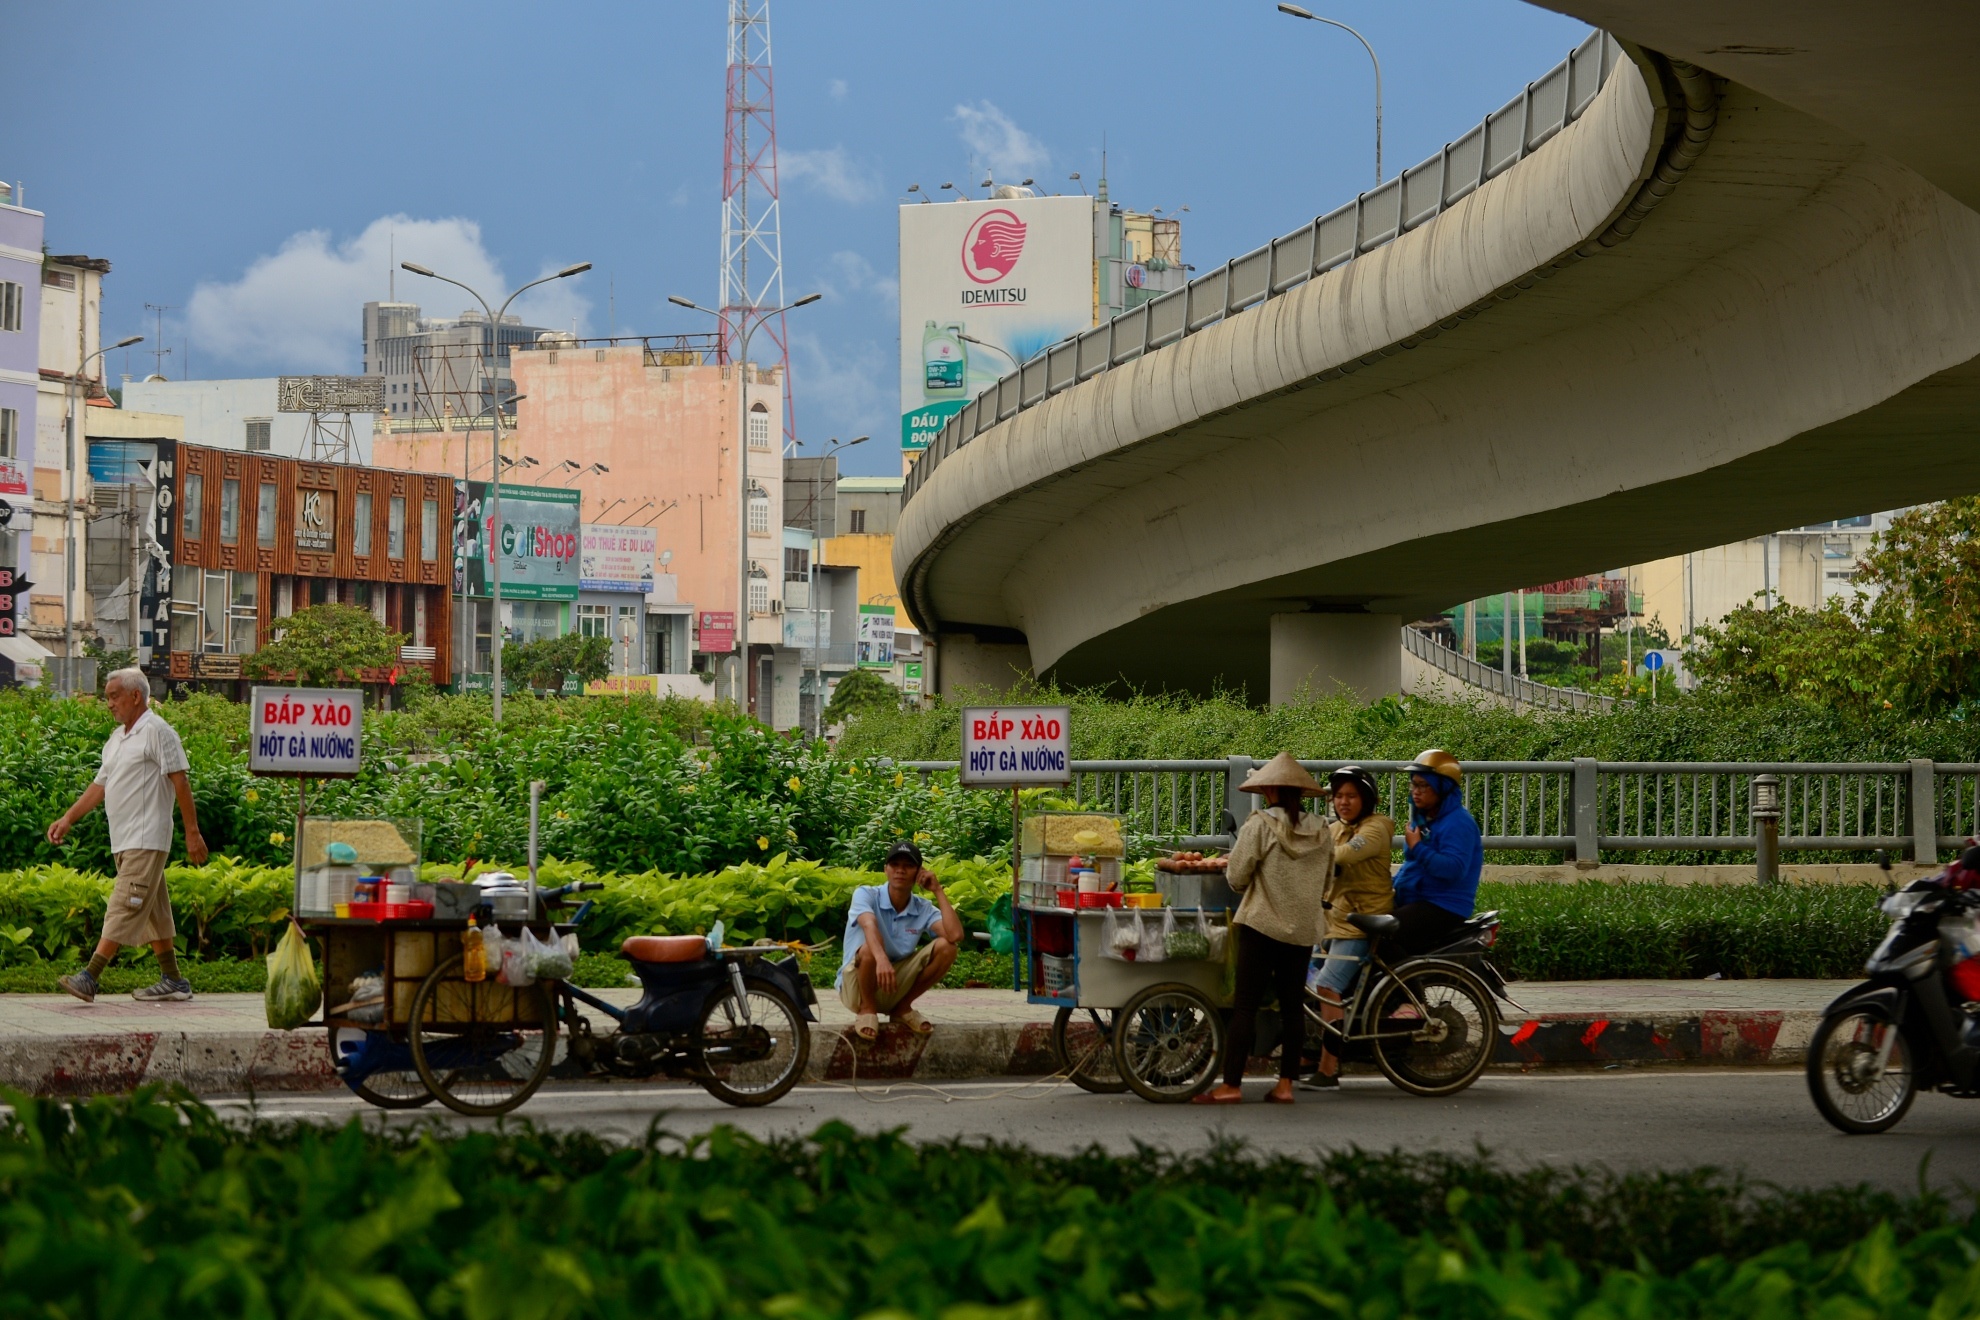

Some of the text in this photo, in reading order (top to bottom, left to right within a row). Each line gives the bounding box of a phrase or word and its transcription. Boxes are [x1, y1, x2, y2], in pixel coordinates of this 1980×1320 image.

[961, 288, 1026, 304] IDEMITSU
[322, 388, 376, 405] Furniture
[911, 430, 937, 446] ĐỘN
[157, 461, 173, 535] NỘI
[583, 536, 596, 550] CHO
[618, 538, 627, 552] XE
[629, 539, 638, 552] DU
[629, 680, 637, 691] DU
[264, 693, 351, 726] BẮP XÀO
[973, 711, 1061, 740] BẮP XÀO
[259, 730, 354, 762] HỘT GÀ NƯỚNG
[970, 744, 1064, 776] HỘT GÀ NƯỚNG
